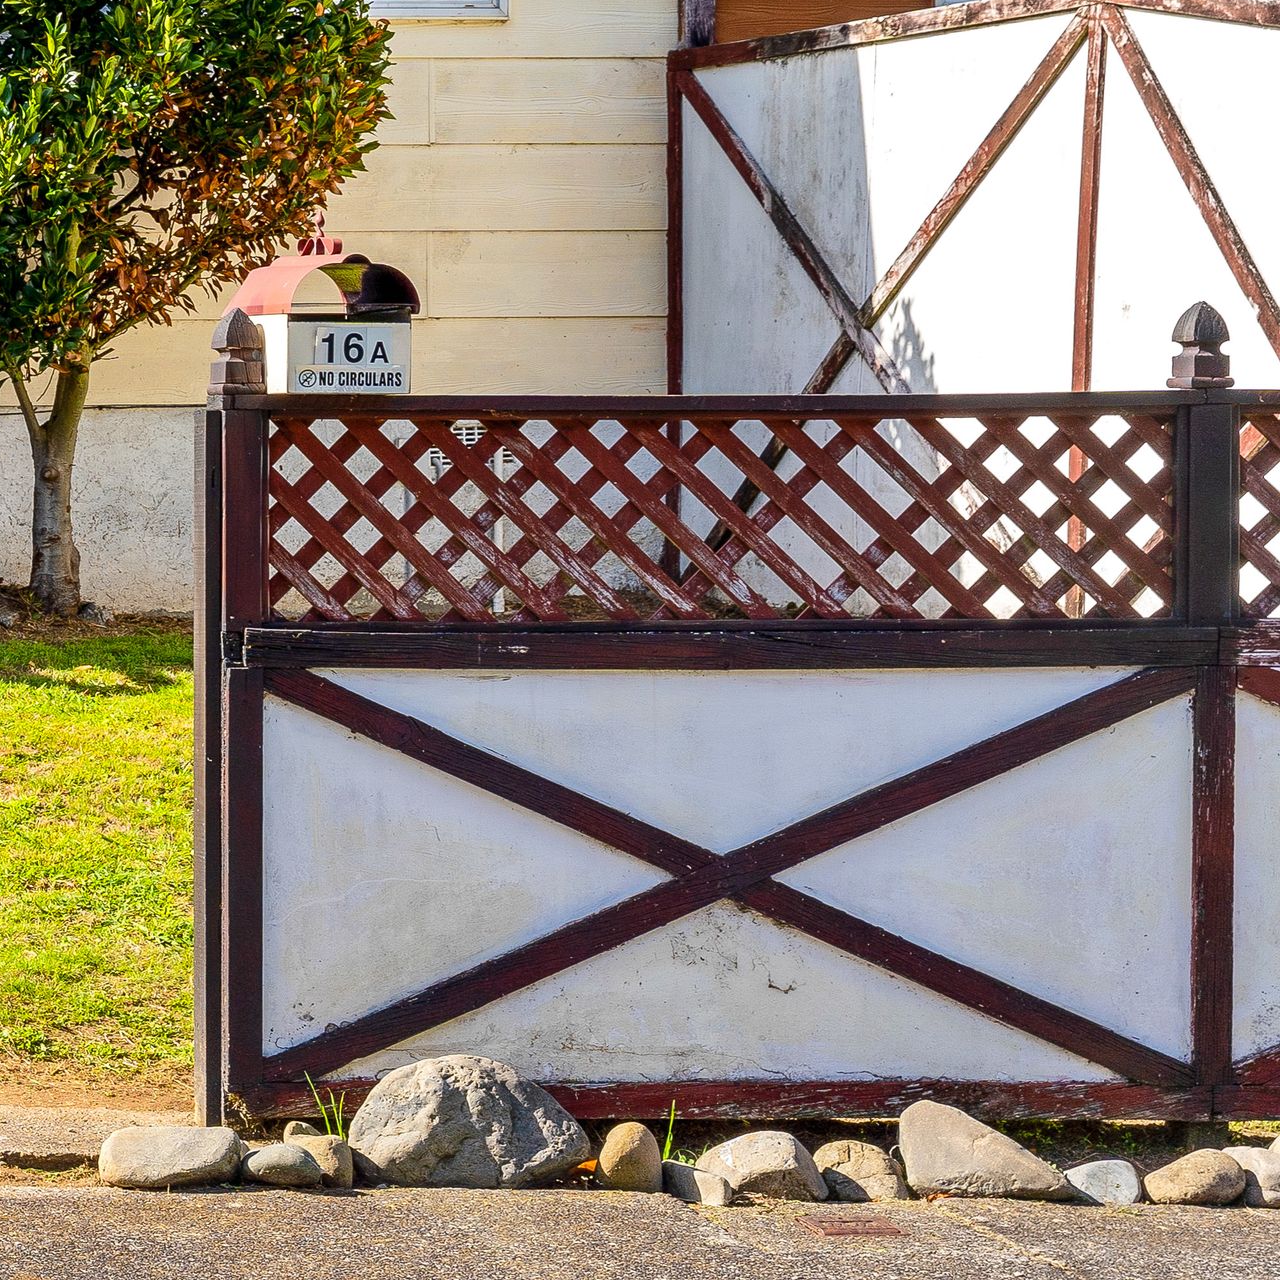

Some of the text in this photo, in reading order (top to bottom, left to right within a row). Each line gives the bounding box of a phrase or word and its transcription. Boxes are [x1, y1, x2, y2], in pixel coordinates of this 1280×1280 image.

[321, 332, 389, 364] 16A
[319, 371, 402, 387] NO CIRCULARS
